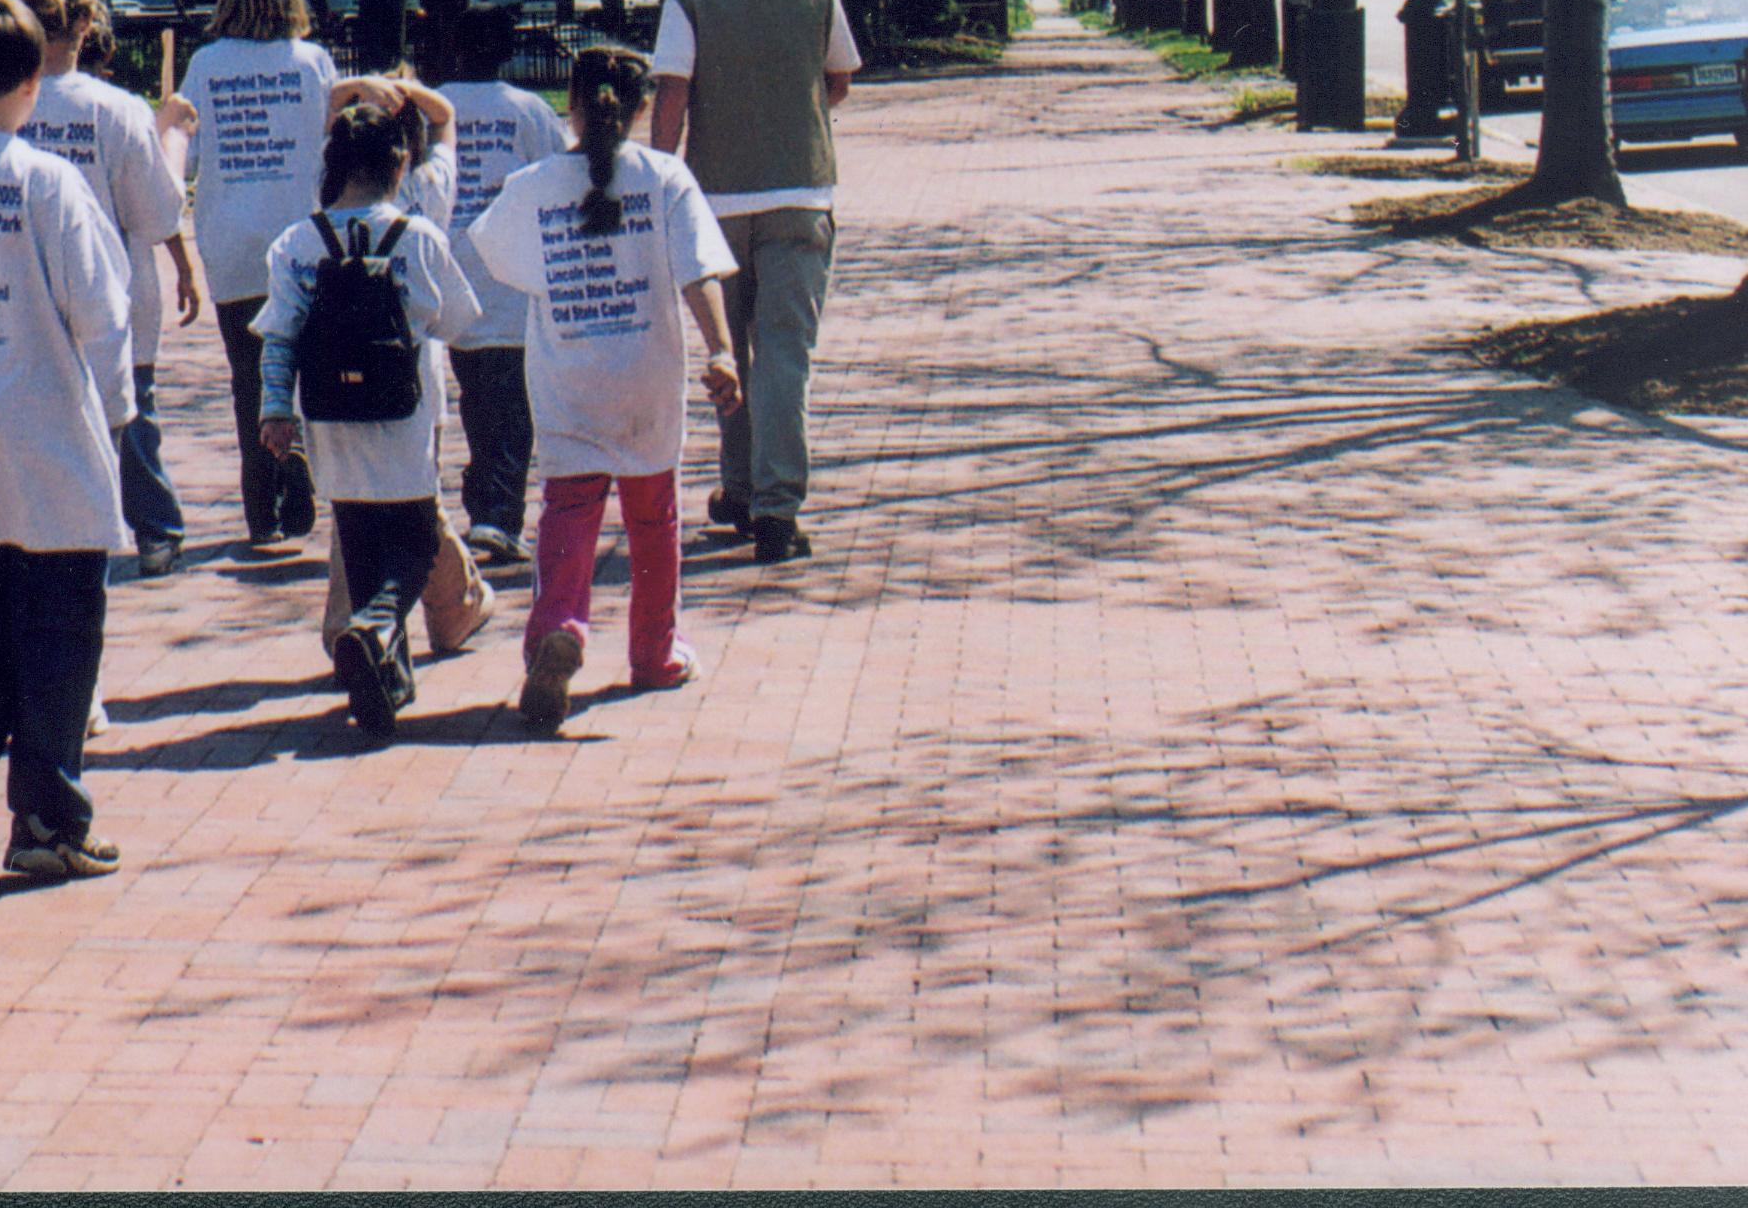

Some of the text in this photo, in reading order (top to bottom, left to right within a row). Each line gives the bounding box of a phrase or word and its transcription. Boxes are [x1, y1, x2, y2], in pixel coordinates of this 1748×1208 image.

[40, 122, 65, 140] Tour
[622, 193, 651, 212] 2005
[542, 232, 565, 245] New
[544, 244, 613, 265] Lincoln Tomb
[546, 264, 617, 285] Lincoln Home
[548, 286, 585, 303] Illinois
[586, 283, 613, 300] State
[552, 306, 571, 323] Old
[572, 304, 600, 323] State
